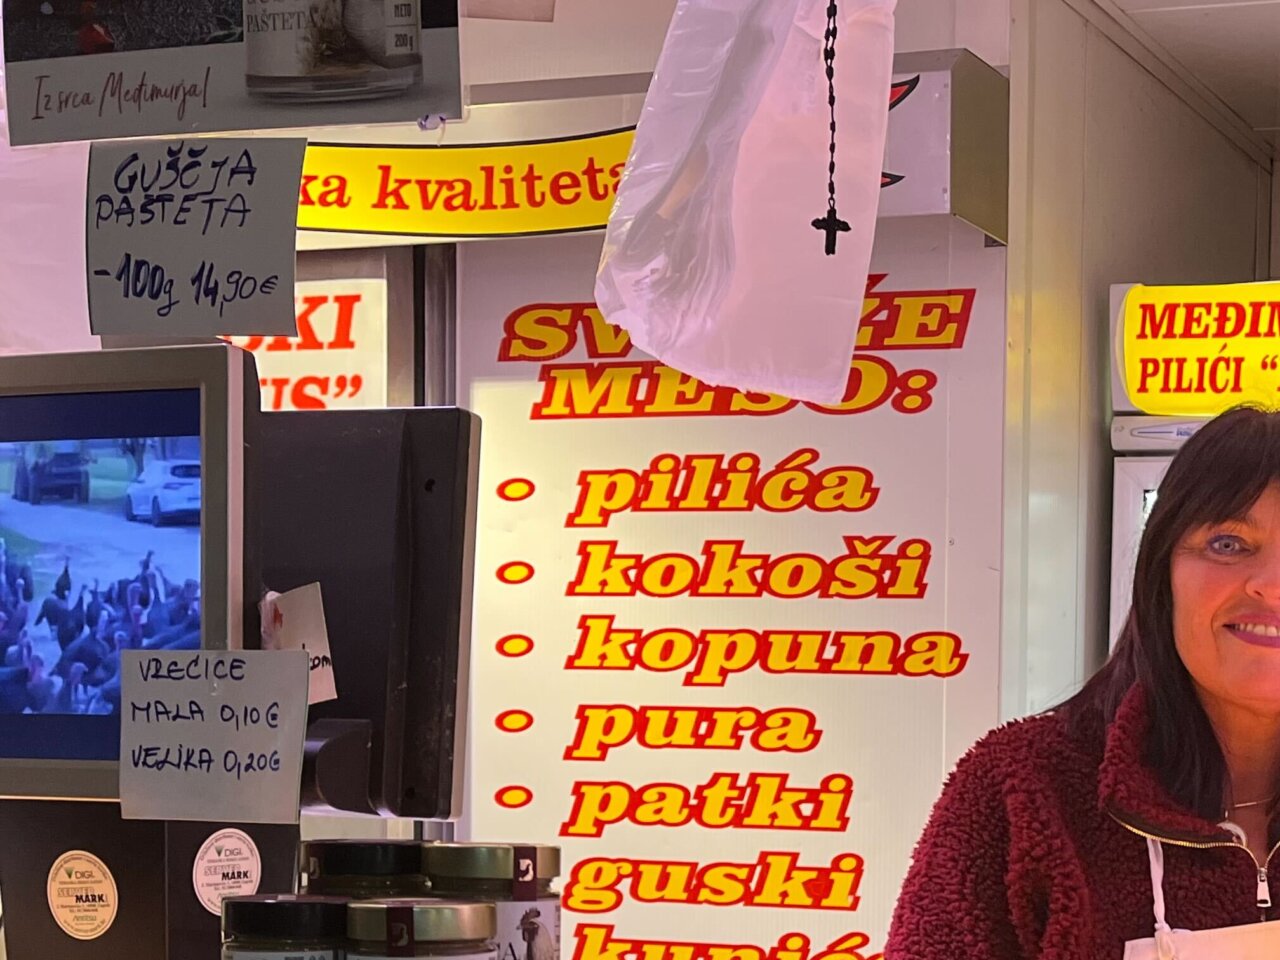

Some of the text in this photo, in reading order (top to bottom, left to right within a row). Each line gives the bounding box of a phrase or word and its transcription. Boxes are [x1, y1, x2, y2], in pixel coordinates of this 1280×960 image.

[95, 193, 251, 235] PAŠTETA
[1137, 343, 1244, 394] PILIĆI
[564, 447, 880, 528] pilića
[565, 535, 932, 599] kokoši
[564, 614, 970, 686] kopuna
[131, 701, 204, 722] MALA
[563, 704, 824, 761] pura
[558, 772, 854, 837] patki
[562, 851, 864, 914] guski
